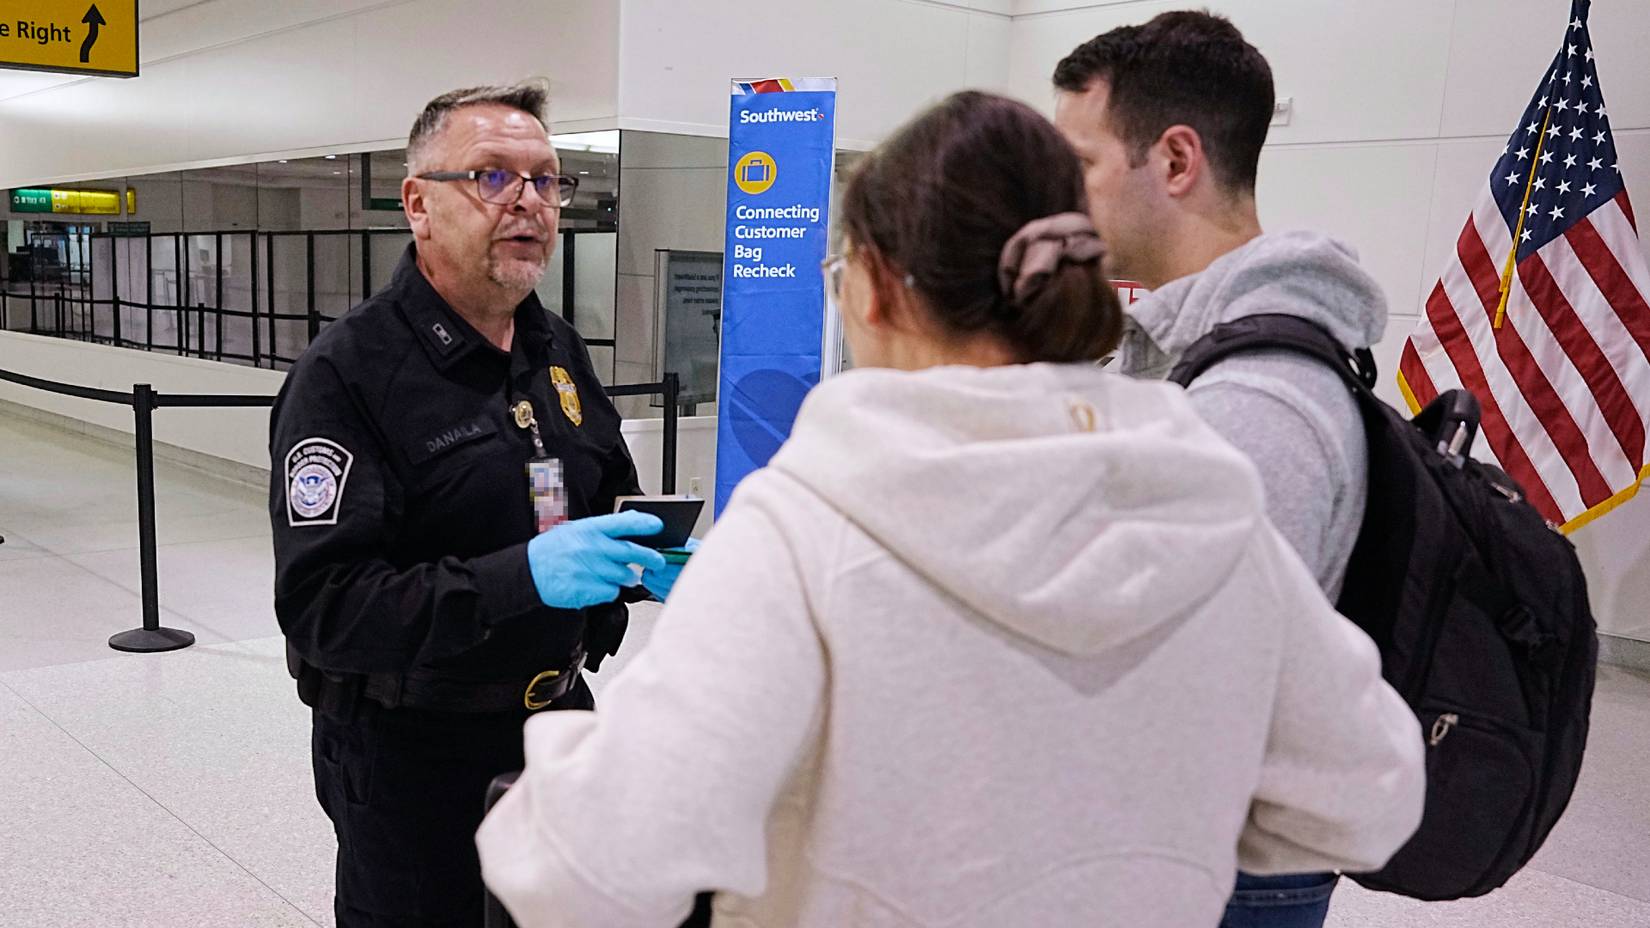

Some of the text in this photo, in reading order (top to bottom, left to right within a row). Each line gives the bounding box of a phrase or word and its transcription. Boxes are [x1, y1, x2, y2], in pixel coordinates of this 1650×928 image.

[17, 21, 72, 45] Right
[740, 107, 817, 124] Southwest
[736, 204, 820, 223] Connecting
[735, 225, 807, 239] Customer
[734, 244, 762, 262] Bag
[733, 263, 796, 278] Recheck
